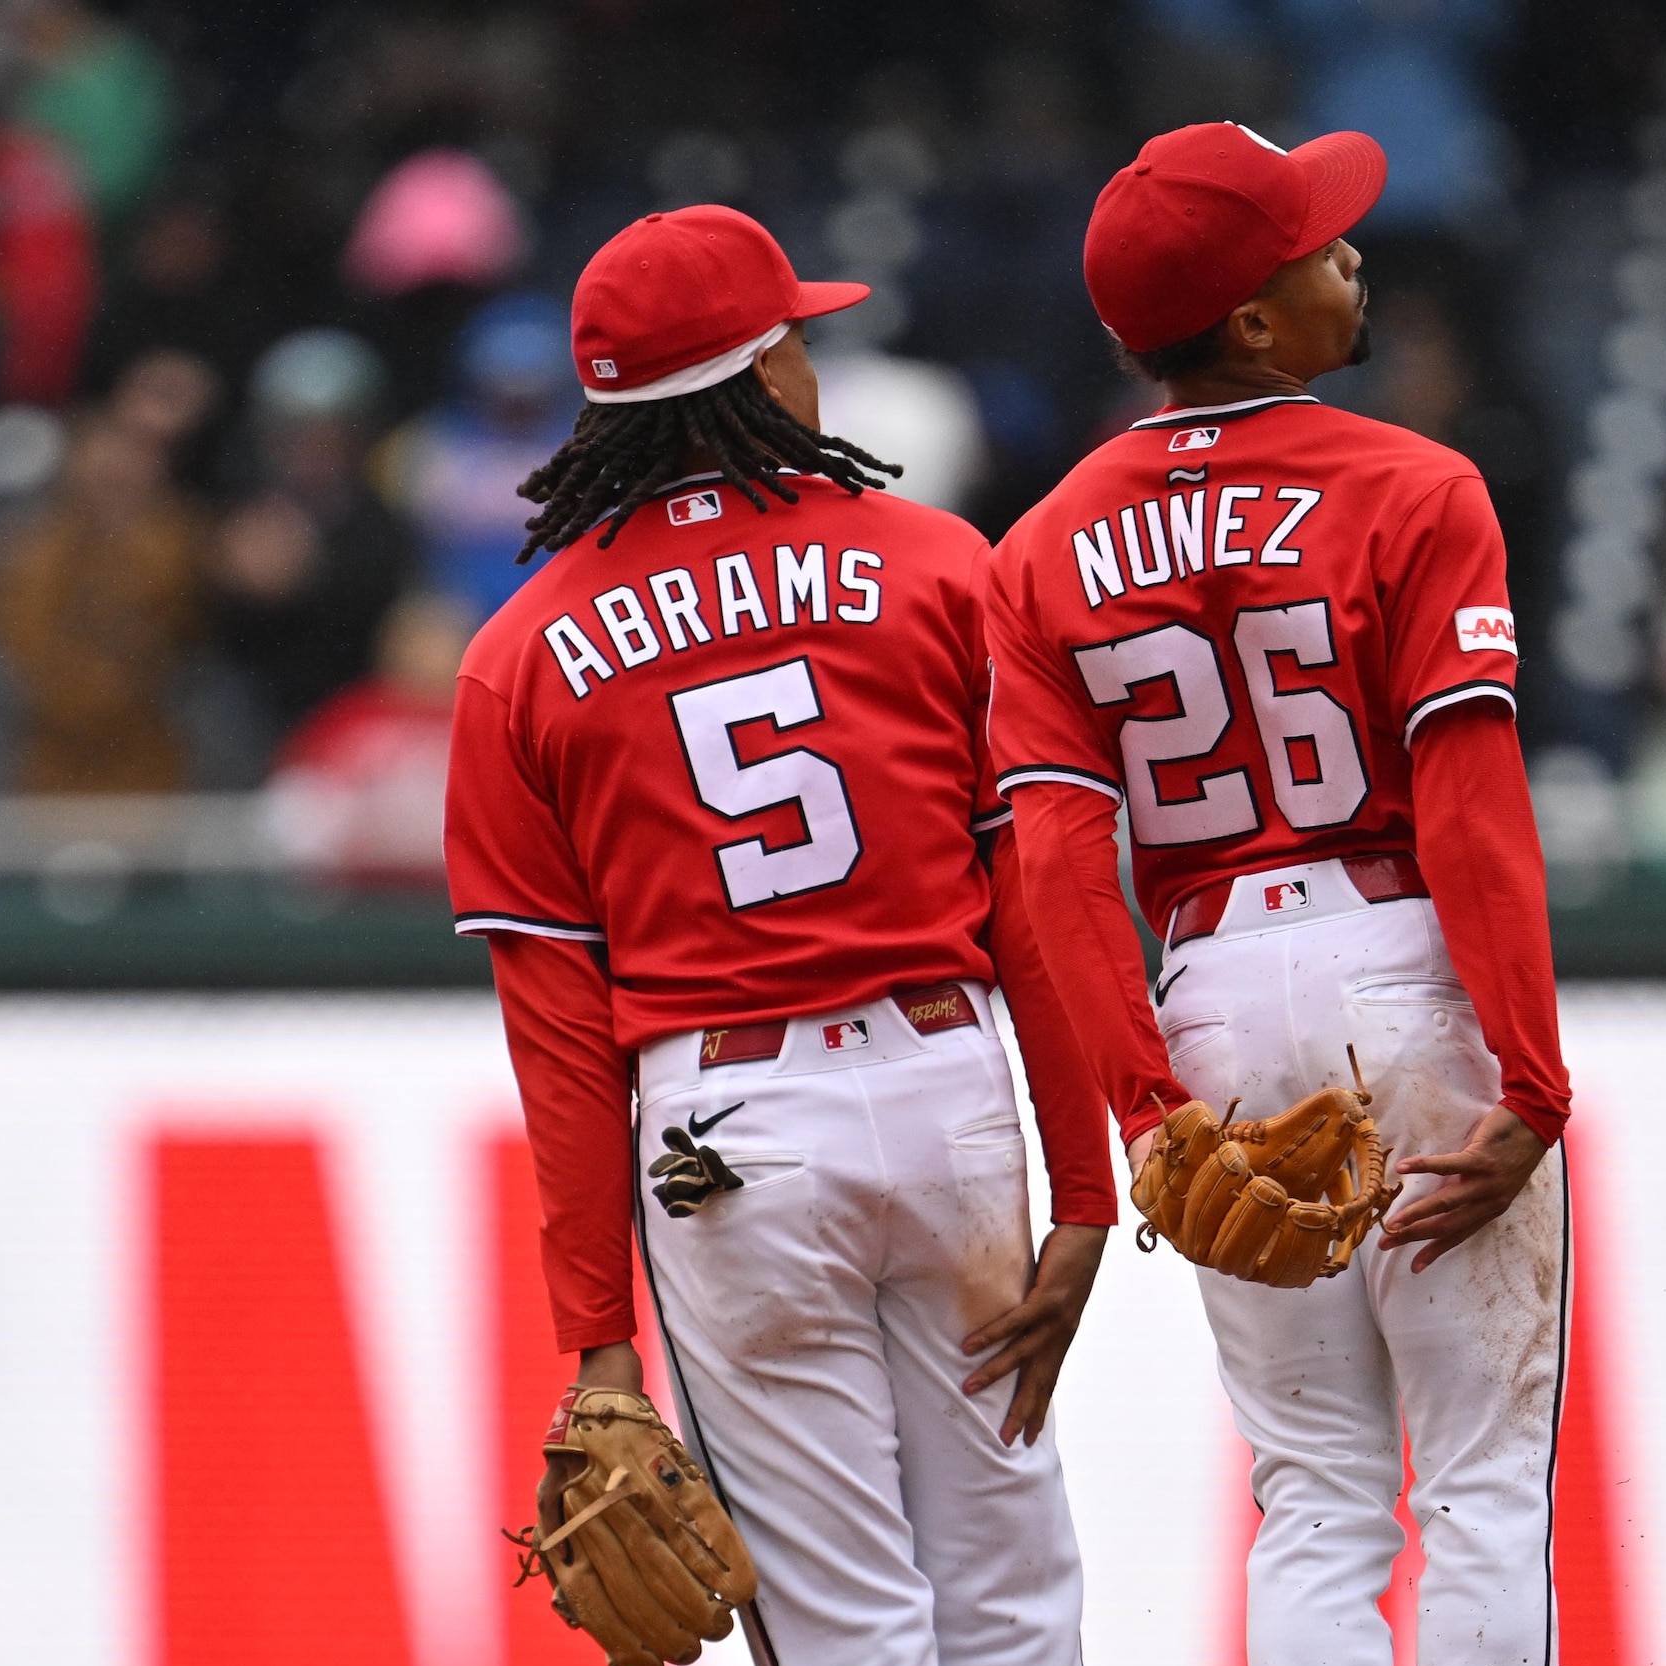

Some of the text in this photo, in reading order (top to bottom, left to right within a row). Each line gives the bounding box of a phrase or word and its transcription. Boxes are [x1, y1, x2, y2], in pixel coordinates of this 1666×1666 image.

[543, 544, 882, 700] ABRAMS
[1072, 462, 1323, 610] NUÑEZ
[667, 656, 863, 912] 5
[1072, 598, 1371, 847] 26
